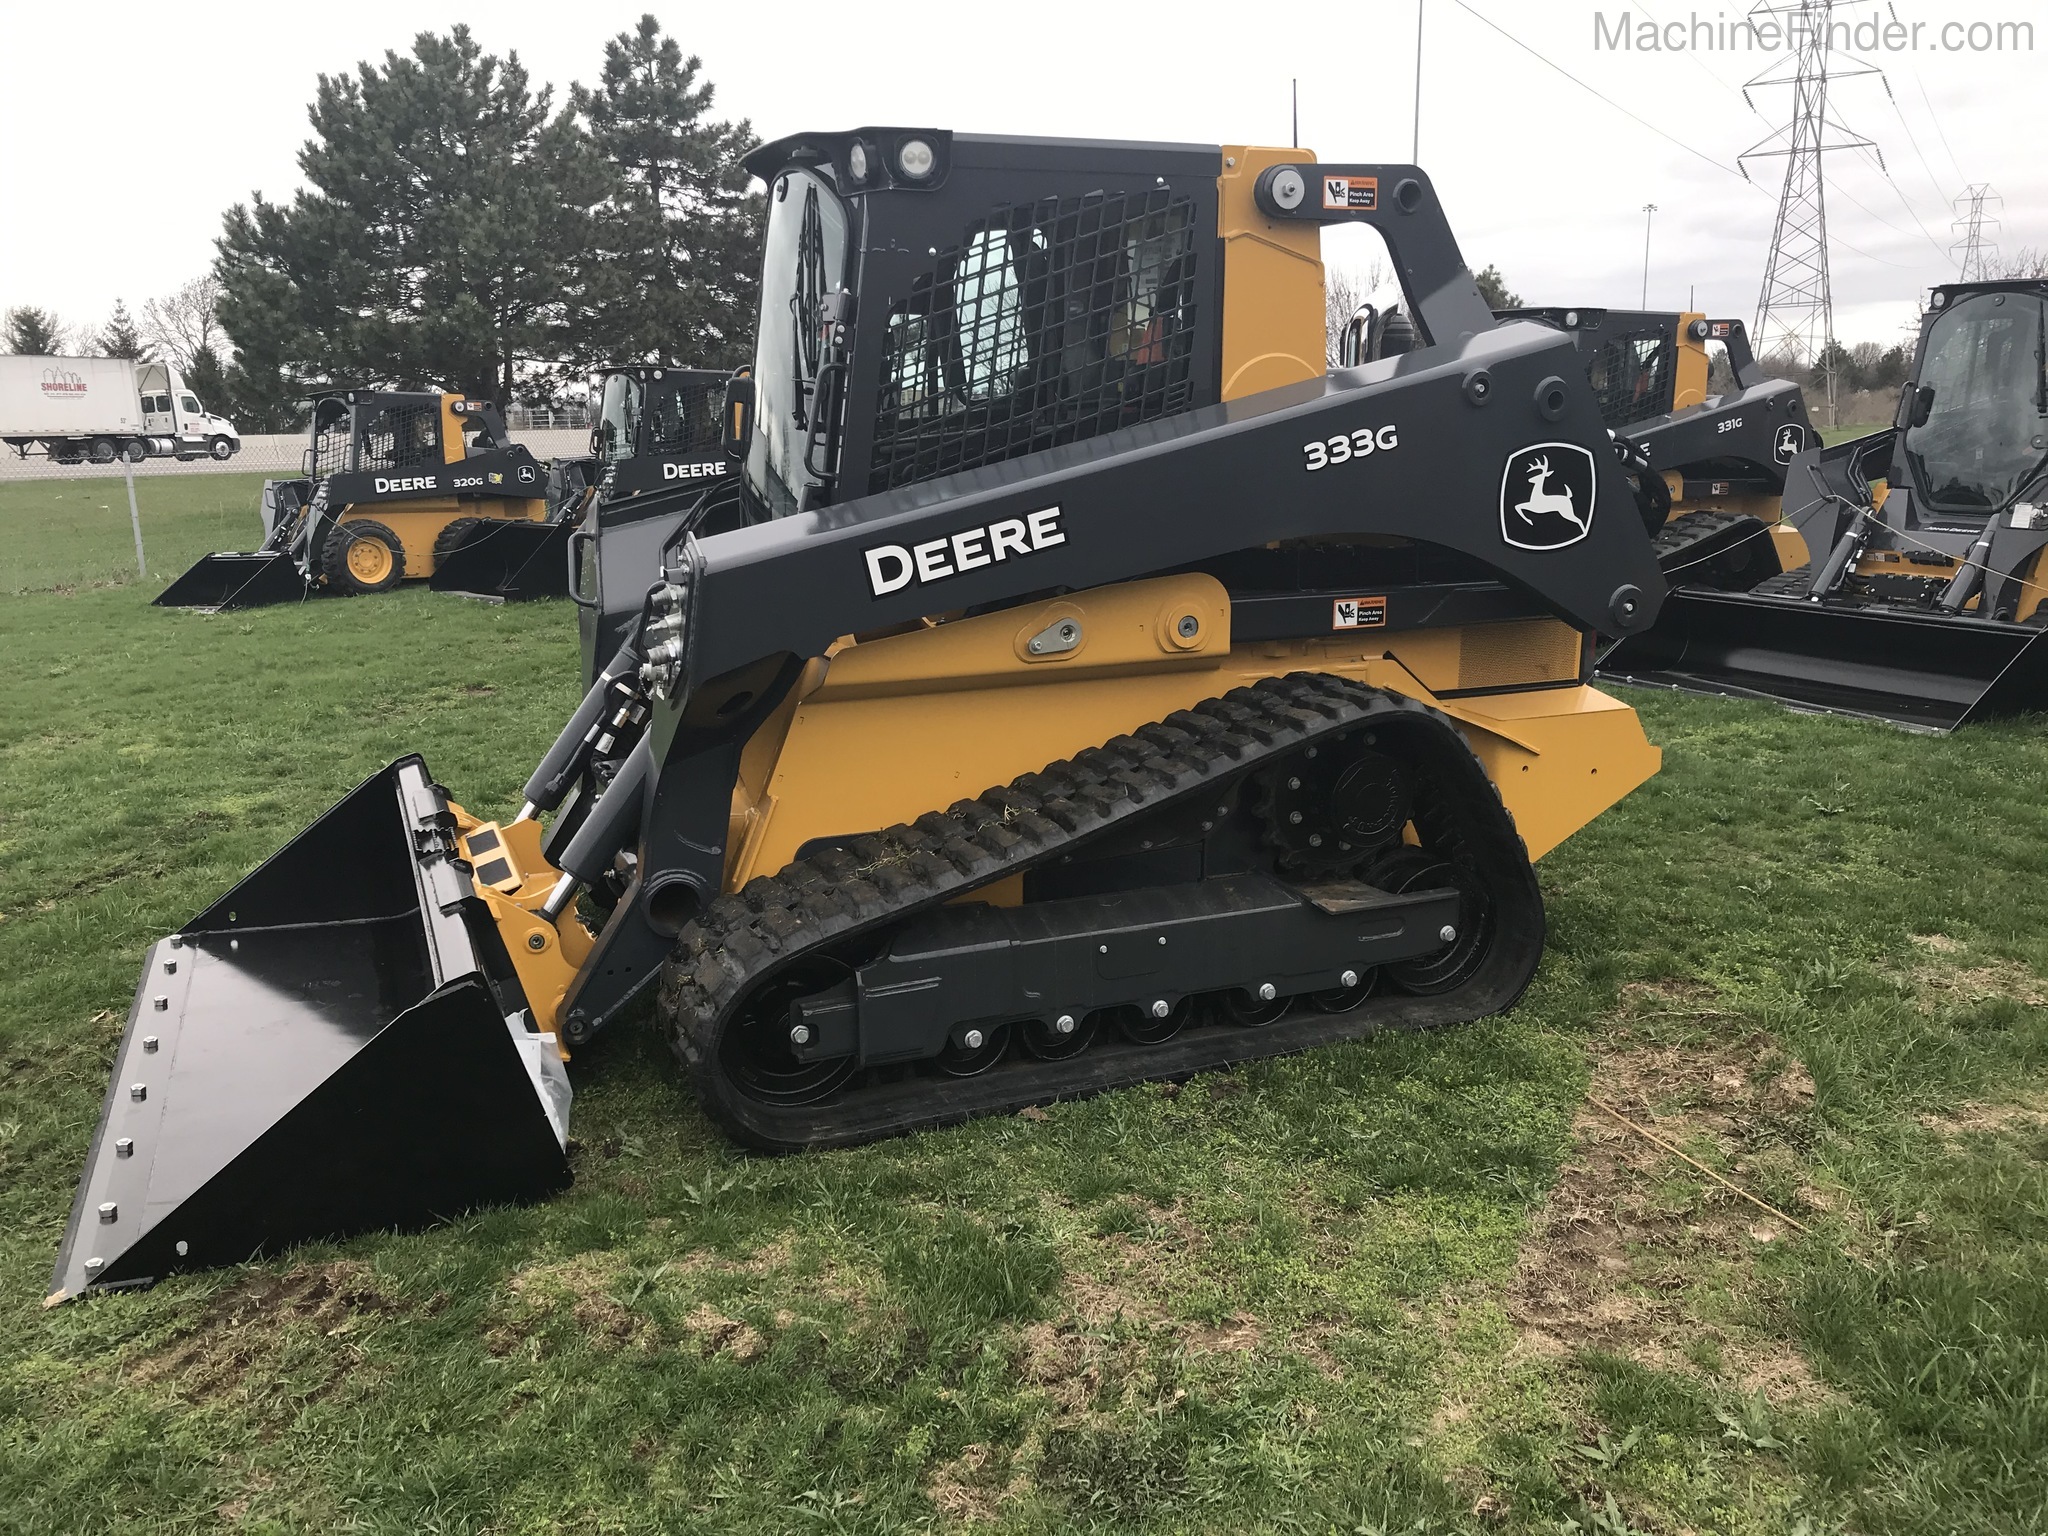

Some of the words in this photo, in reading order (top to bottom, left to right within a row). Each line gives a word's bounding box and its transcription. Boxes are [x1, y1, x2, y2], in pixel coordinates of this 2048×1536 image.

[41, 382, 88, 392] SHORELINE
[1717, 418, 1742, 433] 331G
[1303, 424, 1398, 471] 333G
[663, 461, 727, 480] DEERE
[375, 476, 437, 493] DEERE
[453, 477, 483, 488] 320G
[865, 506, 1066, 596] DEERE
